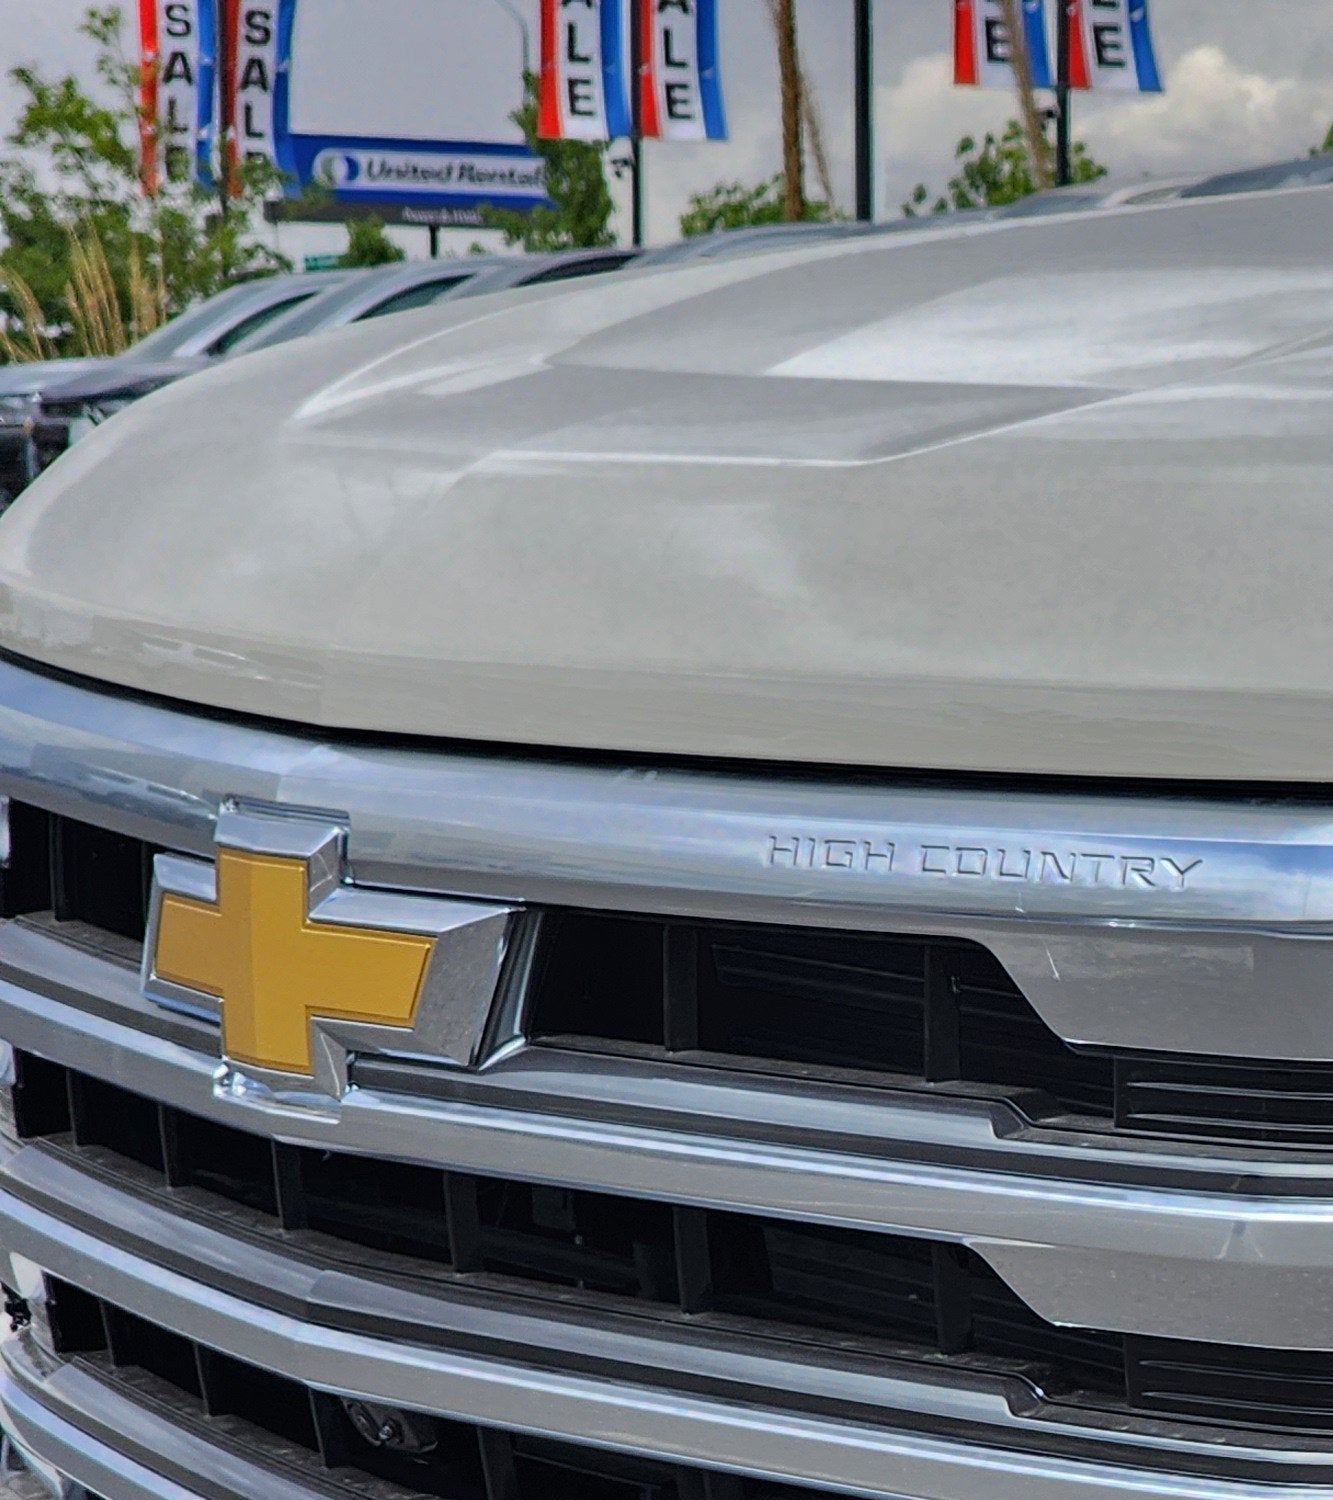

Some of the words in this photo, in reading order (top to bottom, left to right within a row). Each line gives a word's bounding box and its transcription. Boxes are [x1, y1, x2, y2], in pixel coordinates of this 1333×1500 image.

[239, 10, 271, 168] SAL
[768, 834, 895, 872] HIGH
[920, 844, 1203, 891] COUNTRY
